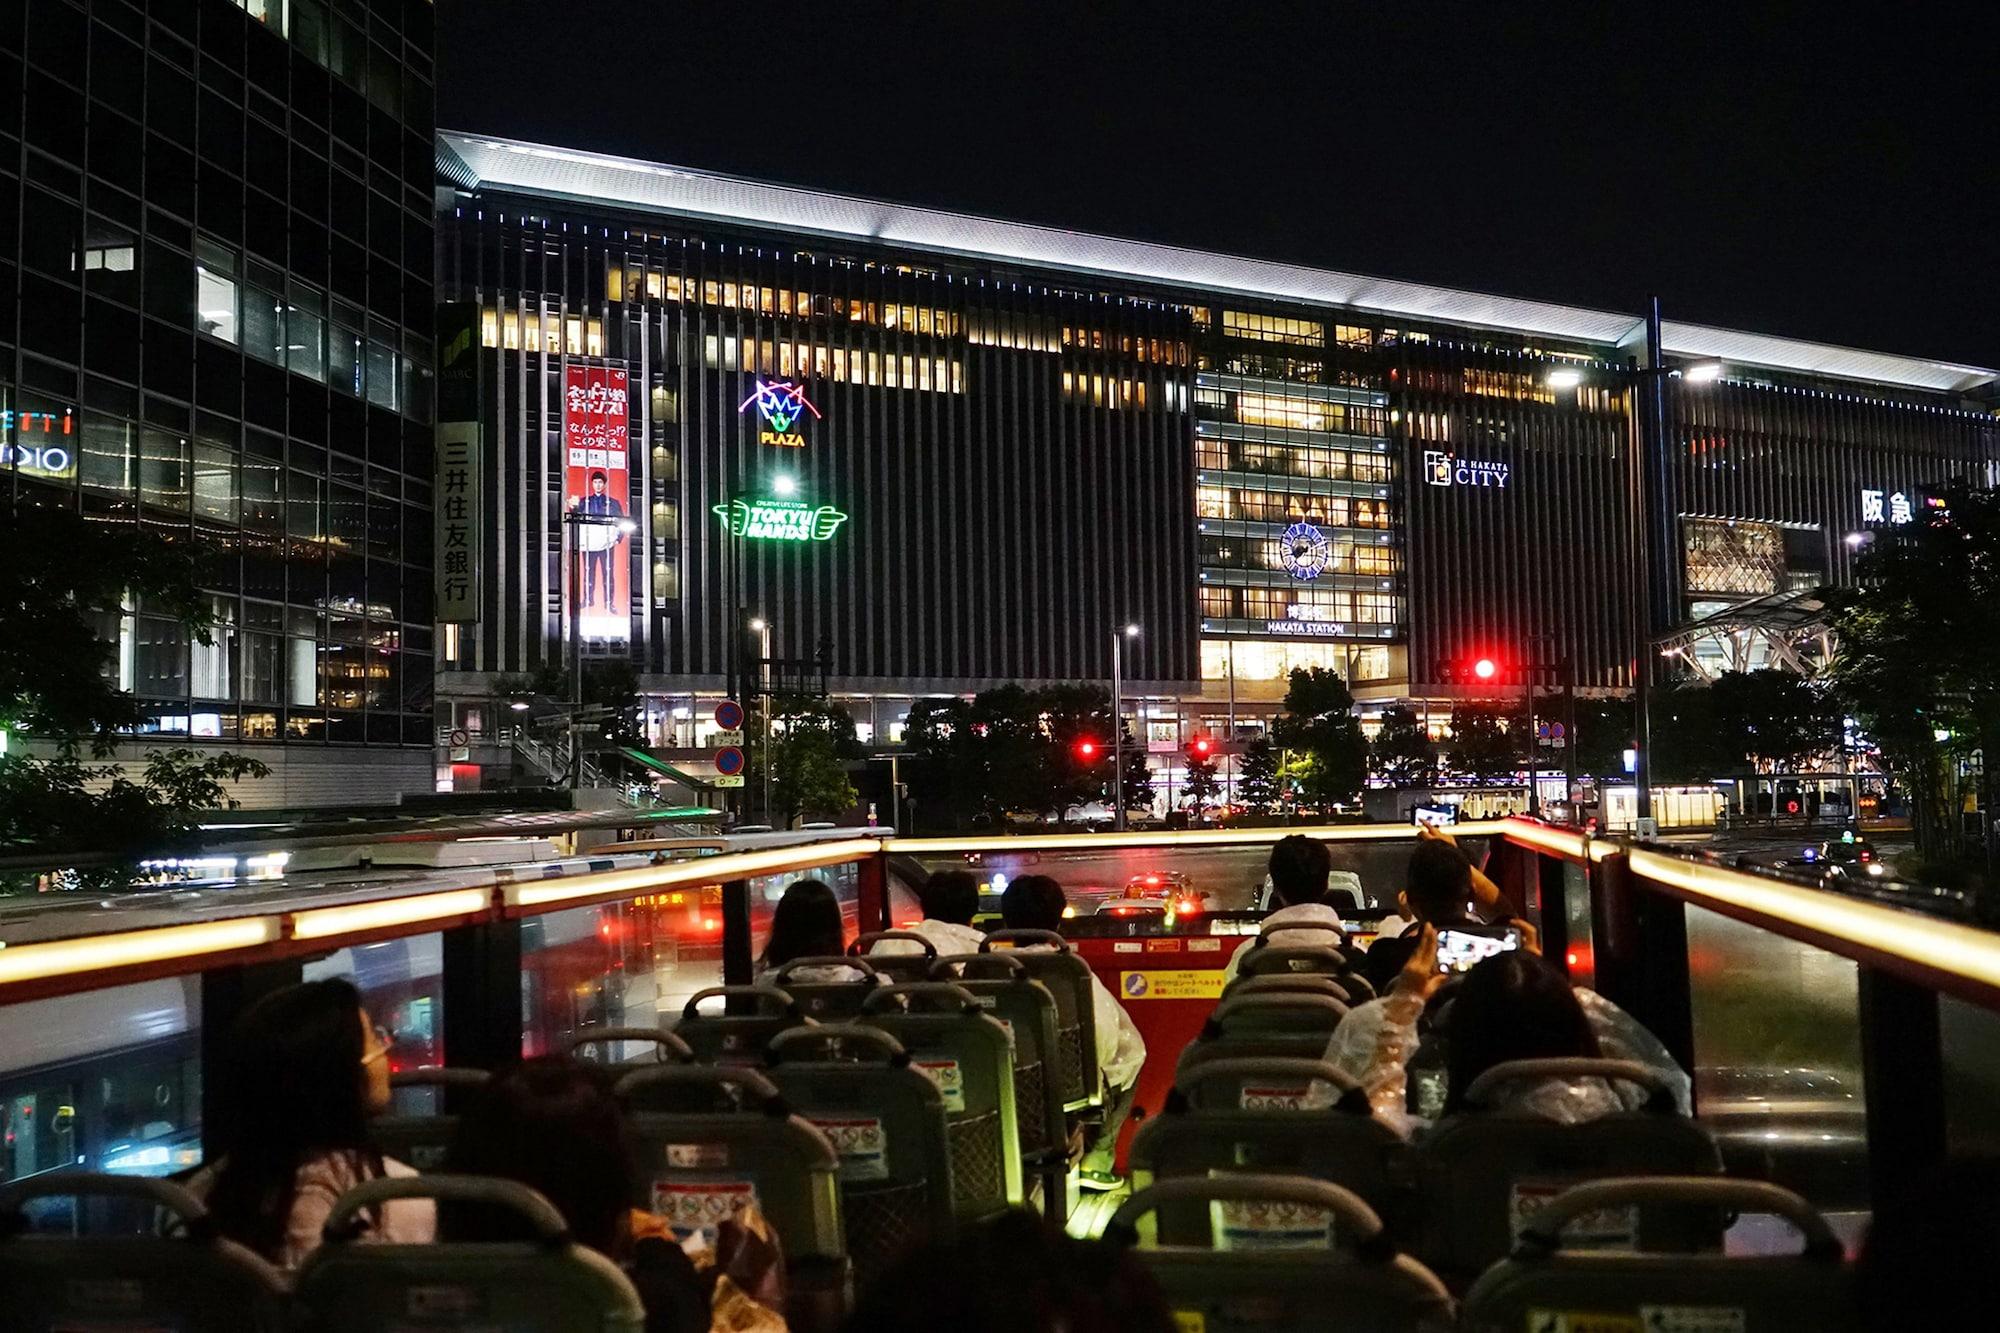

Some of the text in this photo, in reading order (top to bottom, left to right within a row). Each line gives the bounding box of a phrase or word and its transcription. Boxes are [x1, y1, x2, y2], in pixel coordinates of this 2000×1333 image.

[760, 431, 806, 448] PLAZA
[1455, 458, 1509, 472] JR HAKATA
[1455, 468, 1509, 488] CITY
[750, 507, 814, 526] TOKYU
[1861, 489, 1914, 525] 阪急
[444, 440, 470, 604] 三井住友銀行
[747, 522, 810, 541] HANDS
[1267, 621, 1345, 634] HAKATA STATION
